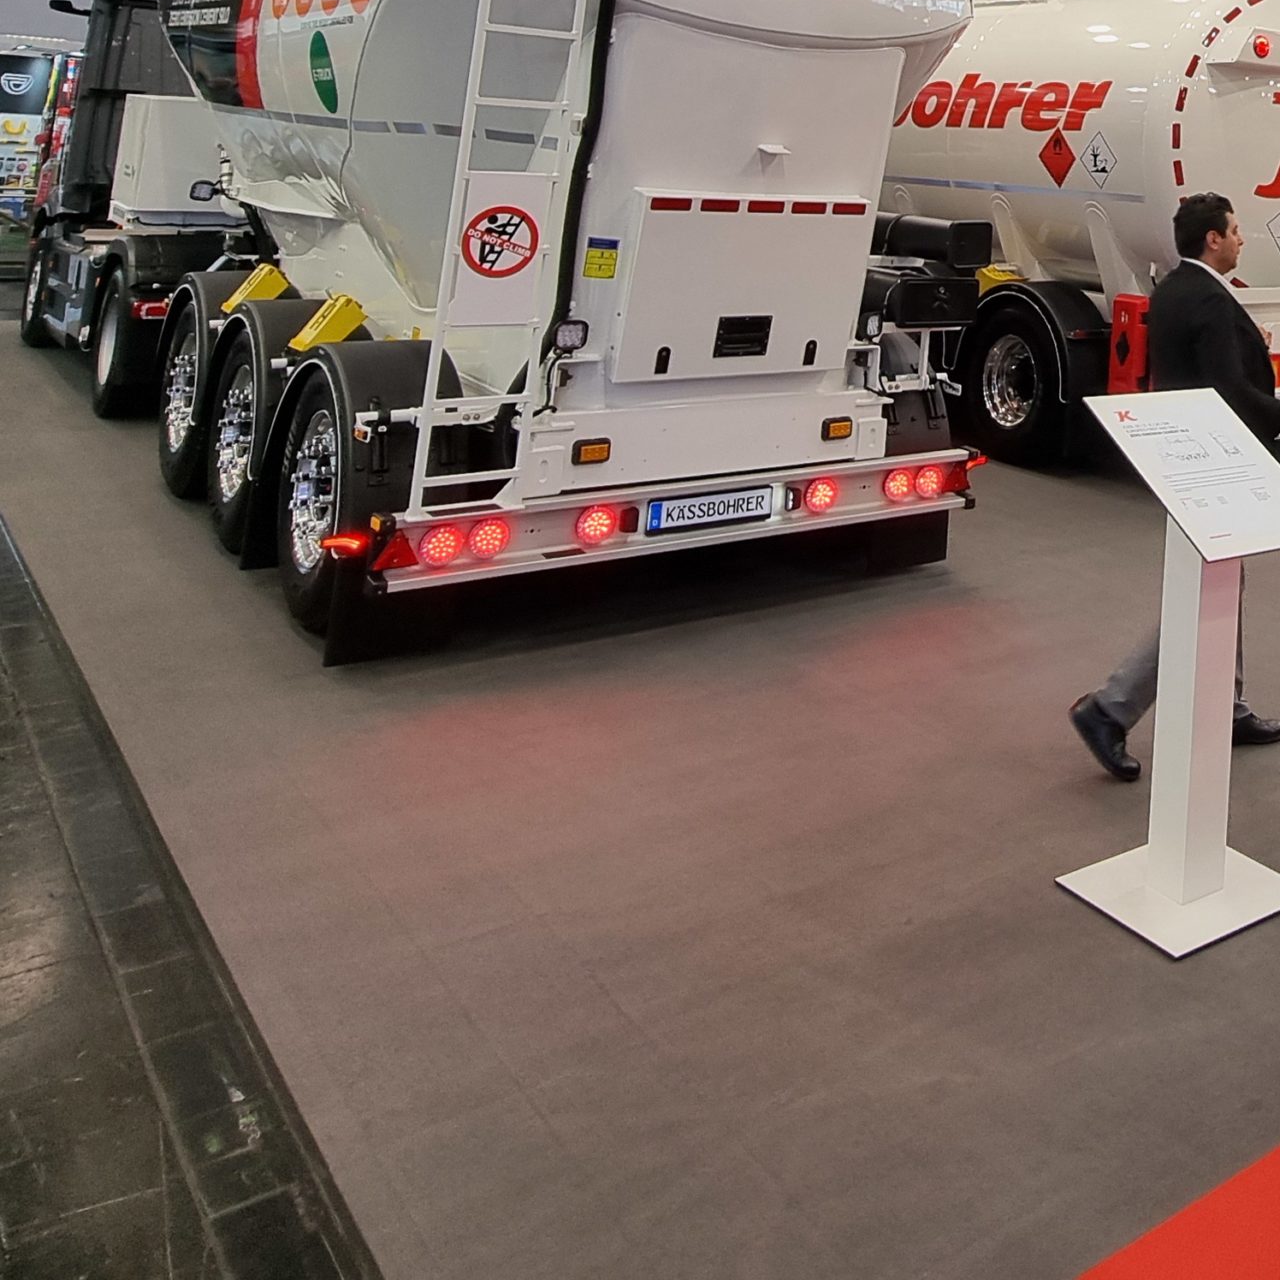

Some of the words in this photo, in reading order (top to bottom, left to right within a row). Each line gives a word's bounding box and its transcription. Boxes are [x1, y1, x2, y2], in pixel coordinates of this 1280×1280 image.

[893, 73, 1113, 131] ohrer
[467, 228, 481, 238] DO
[482, 234, 503, 246] NOT
[503, 242, 531, 257] CLIMB
[665, 495, 765, 523] KÄSSBOHRER
